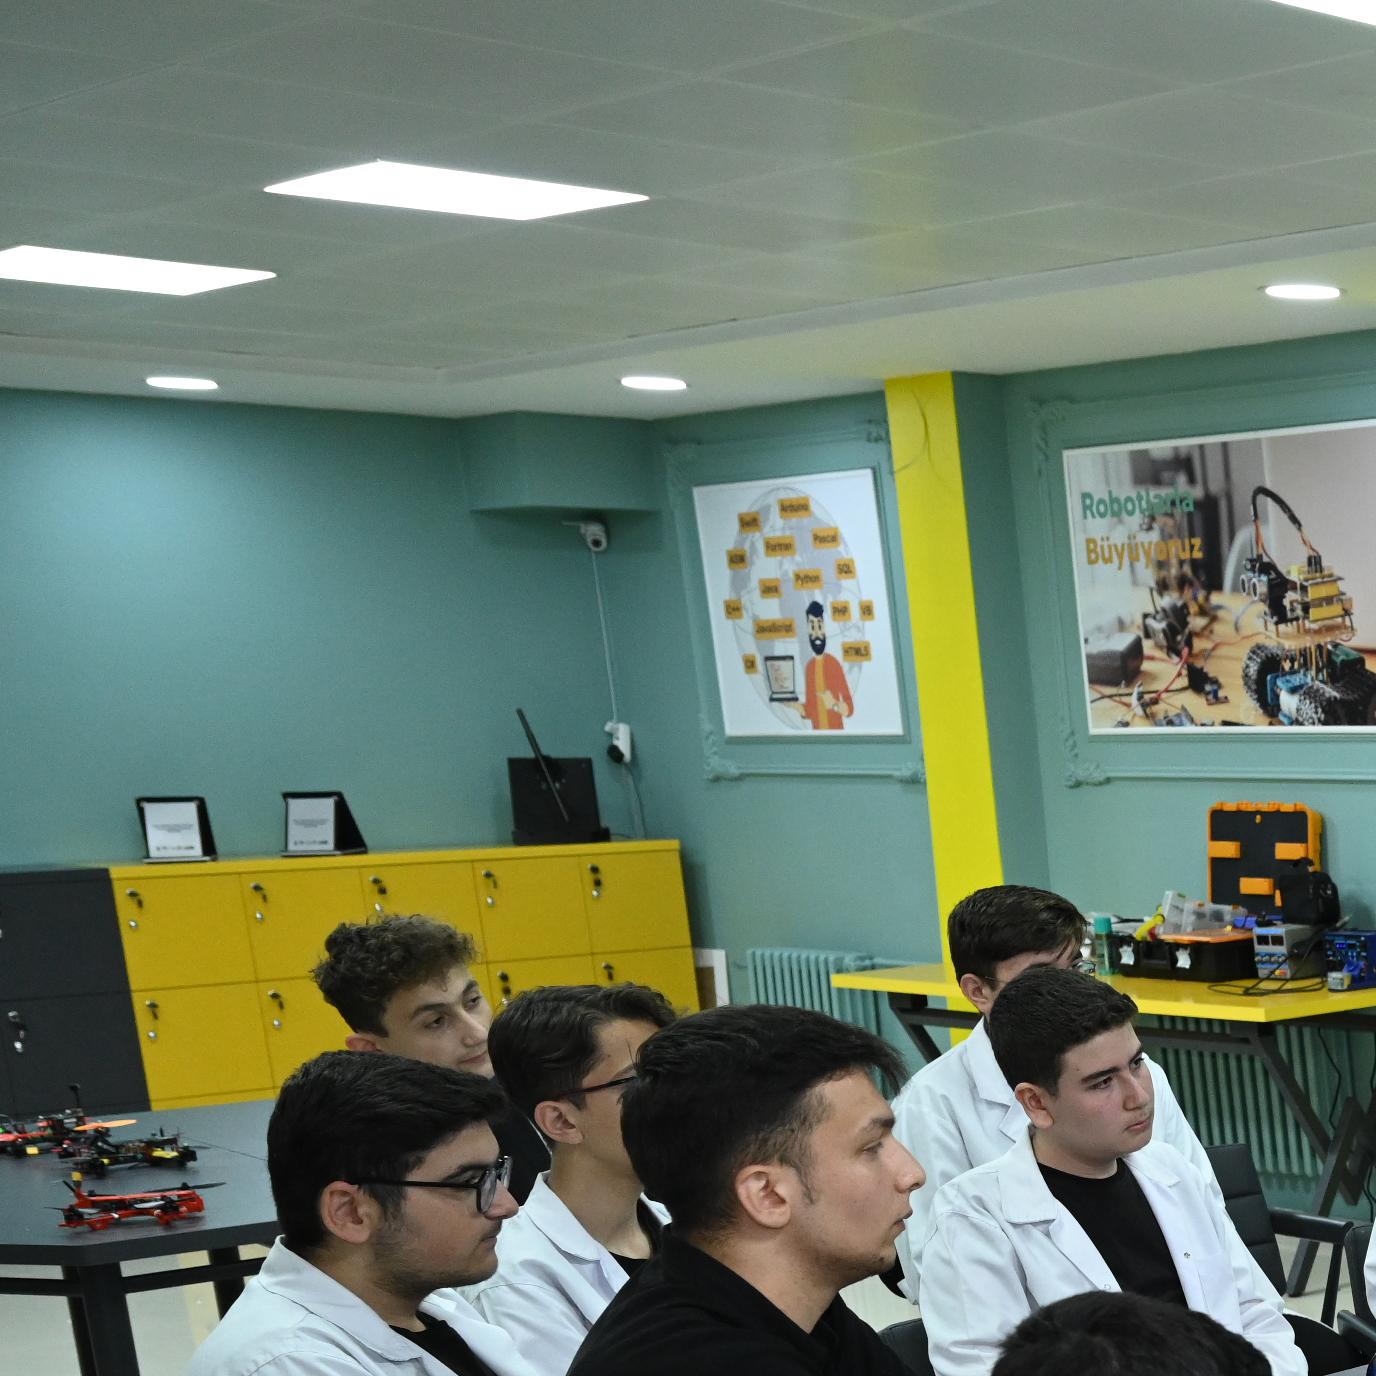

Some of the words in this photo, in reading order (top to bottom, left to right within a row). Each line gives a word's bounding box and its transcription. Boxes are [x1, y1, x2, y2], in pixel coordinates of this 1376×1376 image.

[1080, 483, 1195, 519] Robotlarla
[1085, 533, 1204, 572] Büyüyoruz
[837, 563, 853, 575] SQL
[795, 573, 820, 586] Python
[832, 606, 848, 617] PHP
